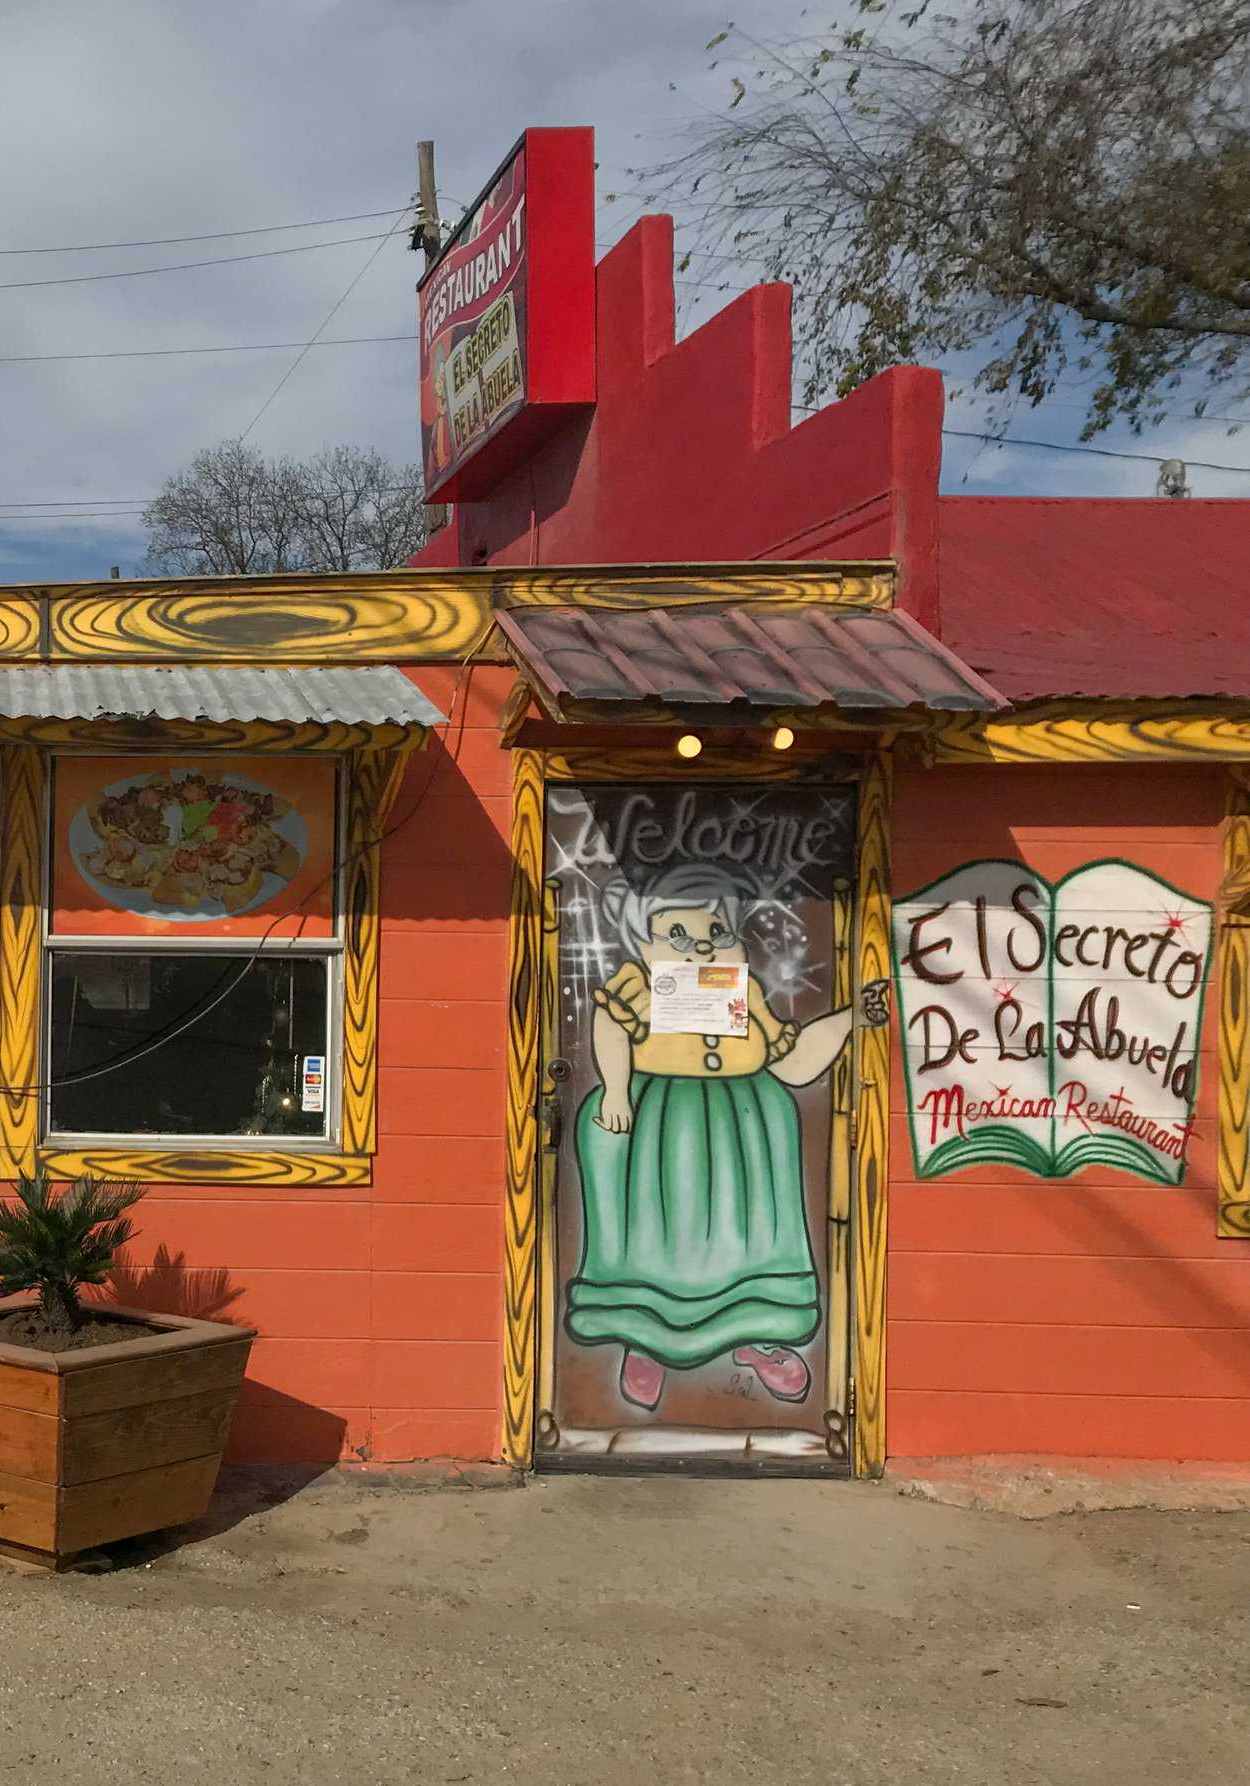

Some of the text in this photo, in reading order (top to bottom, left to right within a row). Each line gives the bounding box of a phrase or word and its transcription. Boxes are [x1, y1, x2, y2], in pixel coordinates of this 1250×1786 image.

[423, 193, 526, 356] RESTAURANT
[453, 297, 511, 395] EL SECRETO
[453, 348, 522, 448] DE LA ABUELA
[551, 791, 841, 866] Welcome
[901, 883, 1204, 999] El Secreto
[908, 987, 1198, 1104] De La Abuela
[917, 1080, 1205, 1159] Mexican Restaurant
